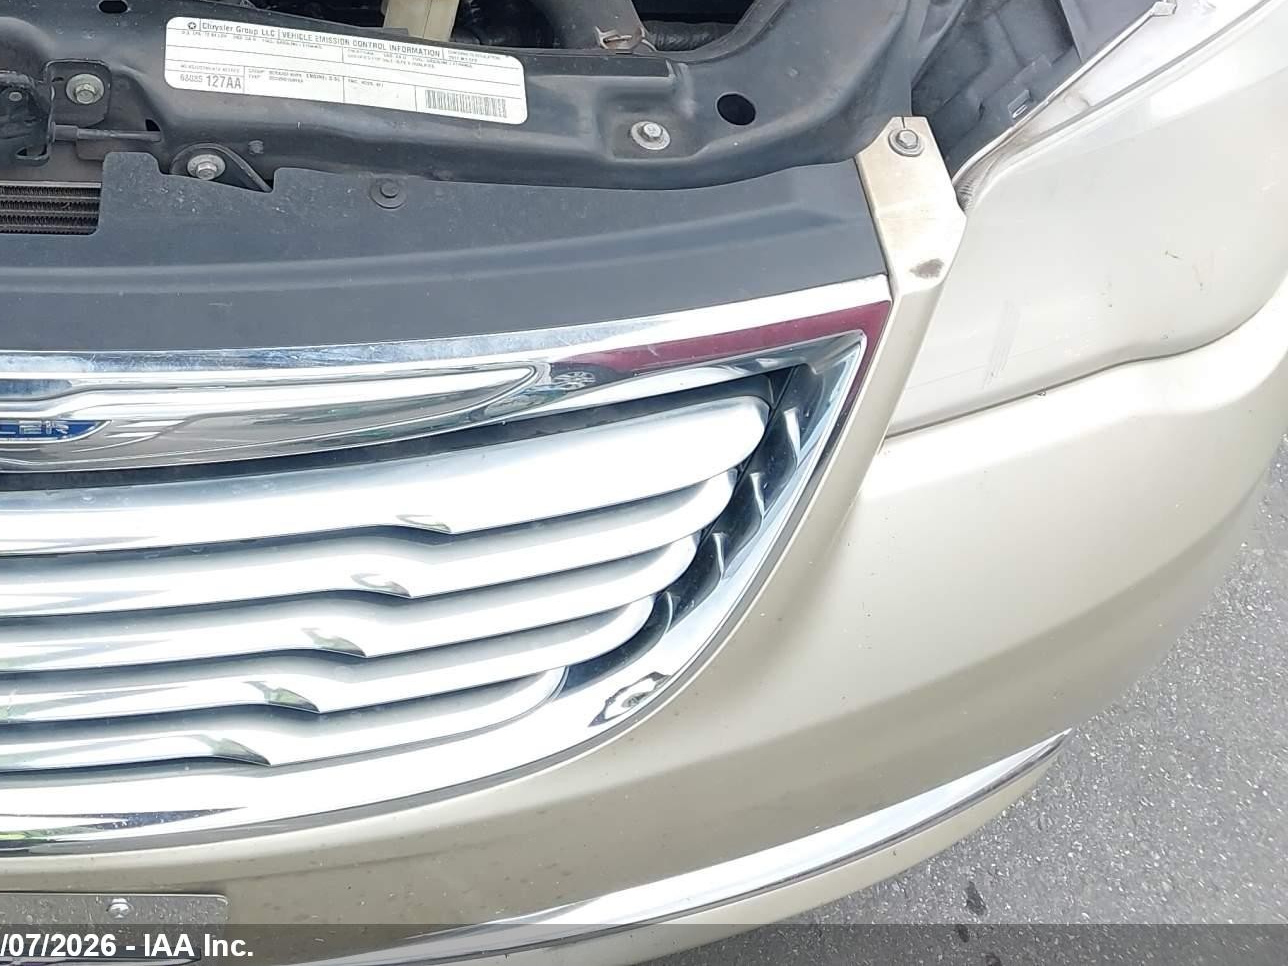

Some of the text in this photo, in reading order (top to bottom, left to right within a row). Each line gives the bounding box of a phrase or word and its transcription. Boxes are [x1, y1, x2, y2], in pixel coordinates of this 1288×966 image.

[202, 21, 233, 32] Chrysler
[236, 25, 258, 35] Group
[261, 29, 275, 37] LLC
[283, 31, 313, 41] VEHICLE
[315, 35, 350, 46] EMISSION
[353, 40, 386, 50] CONTROL
[389, 44, 440, 57] INFORMATION
[206, 75, 242, 89] 127AA
